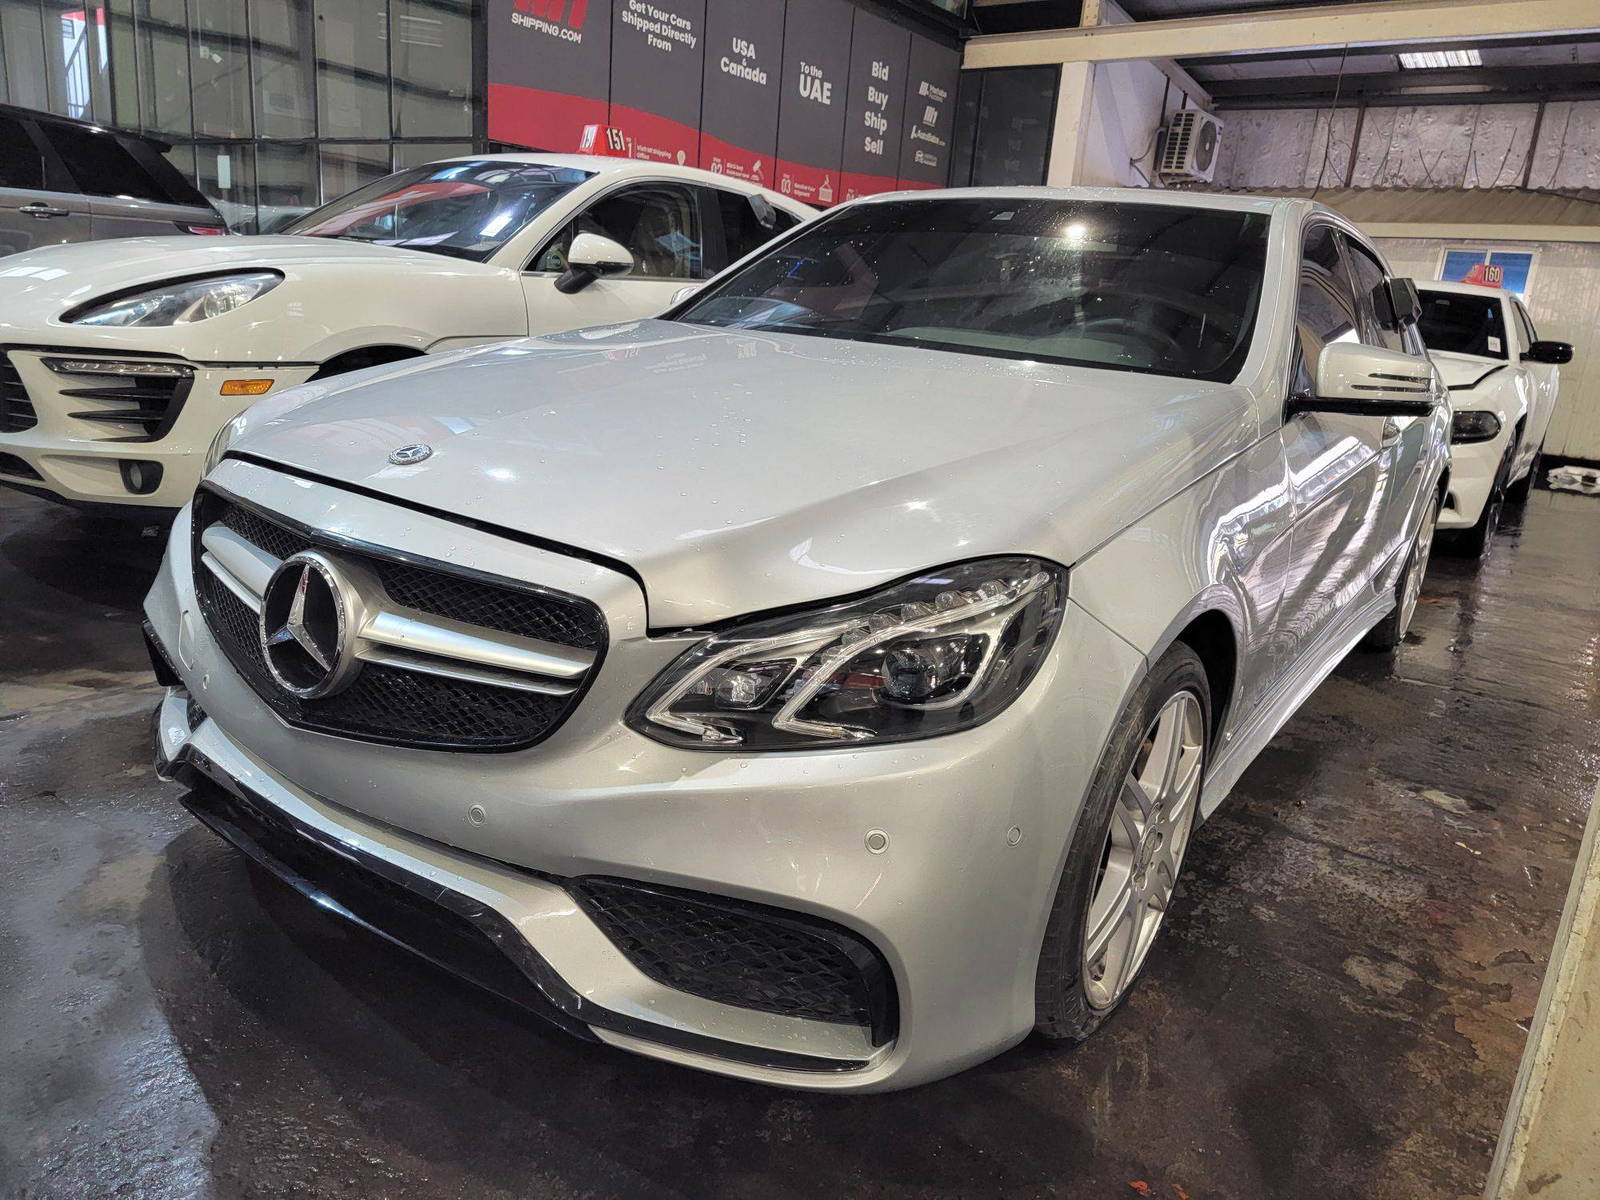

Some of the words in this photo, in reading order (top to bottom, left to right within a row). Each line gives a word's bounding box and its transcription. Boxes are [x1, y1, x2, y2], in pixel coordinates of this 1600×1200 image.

[629, 0, 647, 15] Get
[647, 4, 669, 23] Your
[670, 13, 692, 31] Cars
[511, 13, 582, 44] SHIPPING.COM
[622, 10, 661, 34] Shipped
[662, 24, 697, 49] Directly
[647, 33, 672, 52] From
[732, 37, 756, 60] USA
[720, 57, 767, 86] Canada
[800, 61, 810, 75] To
[810, 65, 823, 79] the
[871, 61, 889, 82] Bid
[799, 75, 832, 105] UAE
[867, 86, 889, 111] Buy
[864, 111, 888, 136] Ship
[606, 127, 626, 151] 151
[864, 136, 884, 156] Sell
[780, 178, 791, 194] 03
[1485, 266, 1500, 282] 160
